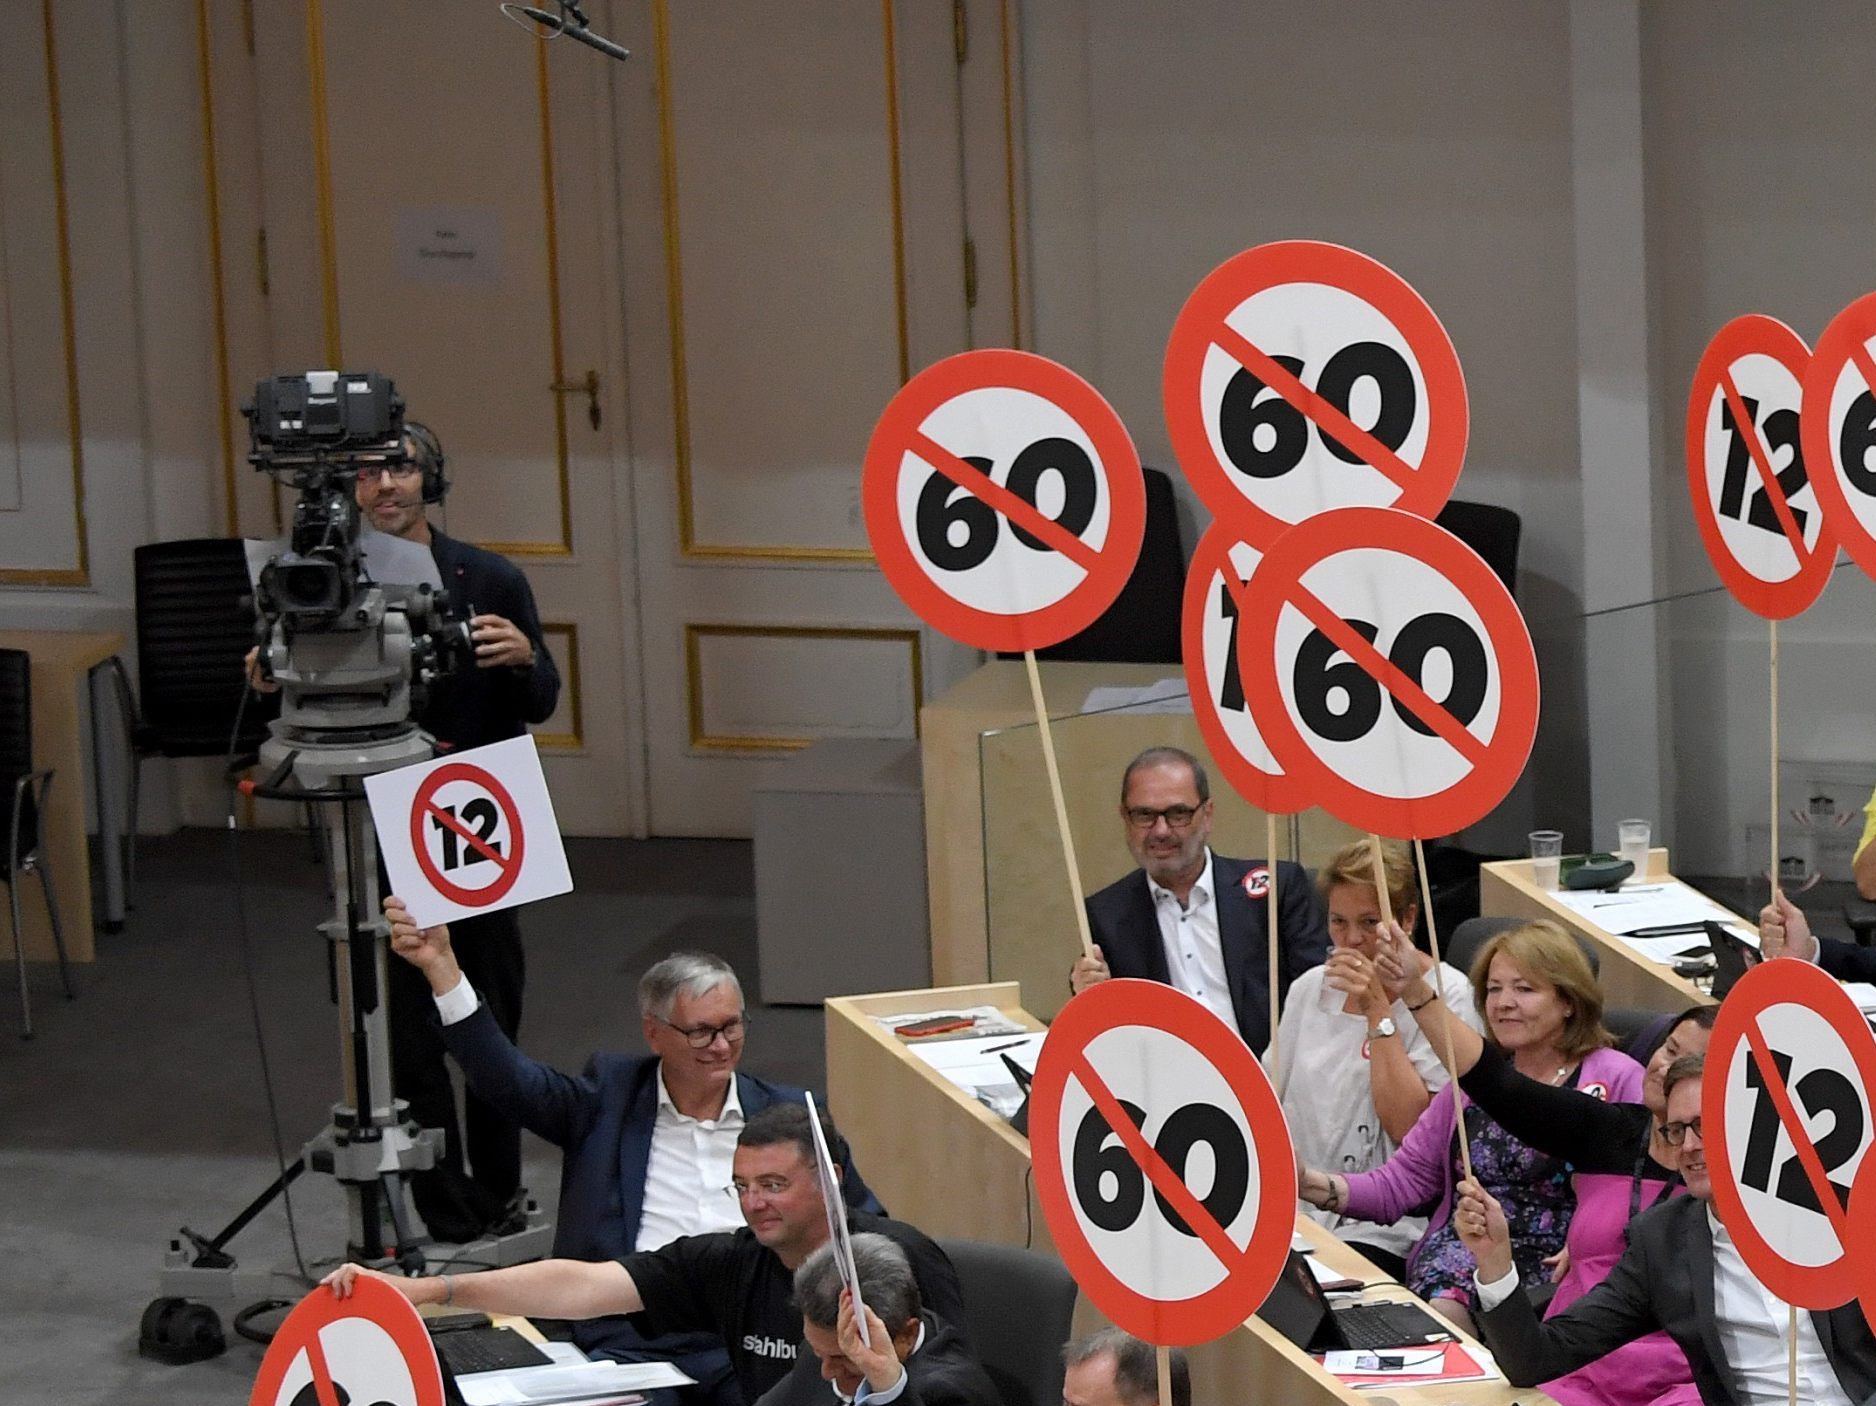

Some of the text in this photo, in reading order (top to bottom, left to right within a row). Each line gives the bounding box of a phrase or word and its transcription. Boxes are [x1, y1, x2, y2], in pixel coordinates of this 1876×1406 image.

[1220, 342, 1416, 478] 60
[1719, 396, 1808, 536] 12
[916, 438, 1096, 571] 60
[1221, 579, 1249, 712] 1
[1293, 613, 1487, 742] 60
[432, 798, 501, 870] 12
[1073, 1099, 1249, 1237] 60
[1741, 1050, 1863, 1215] 12
